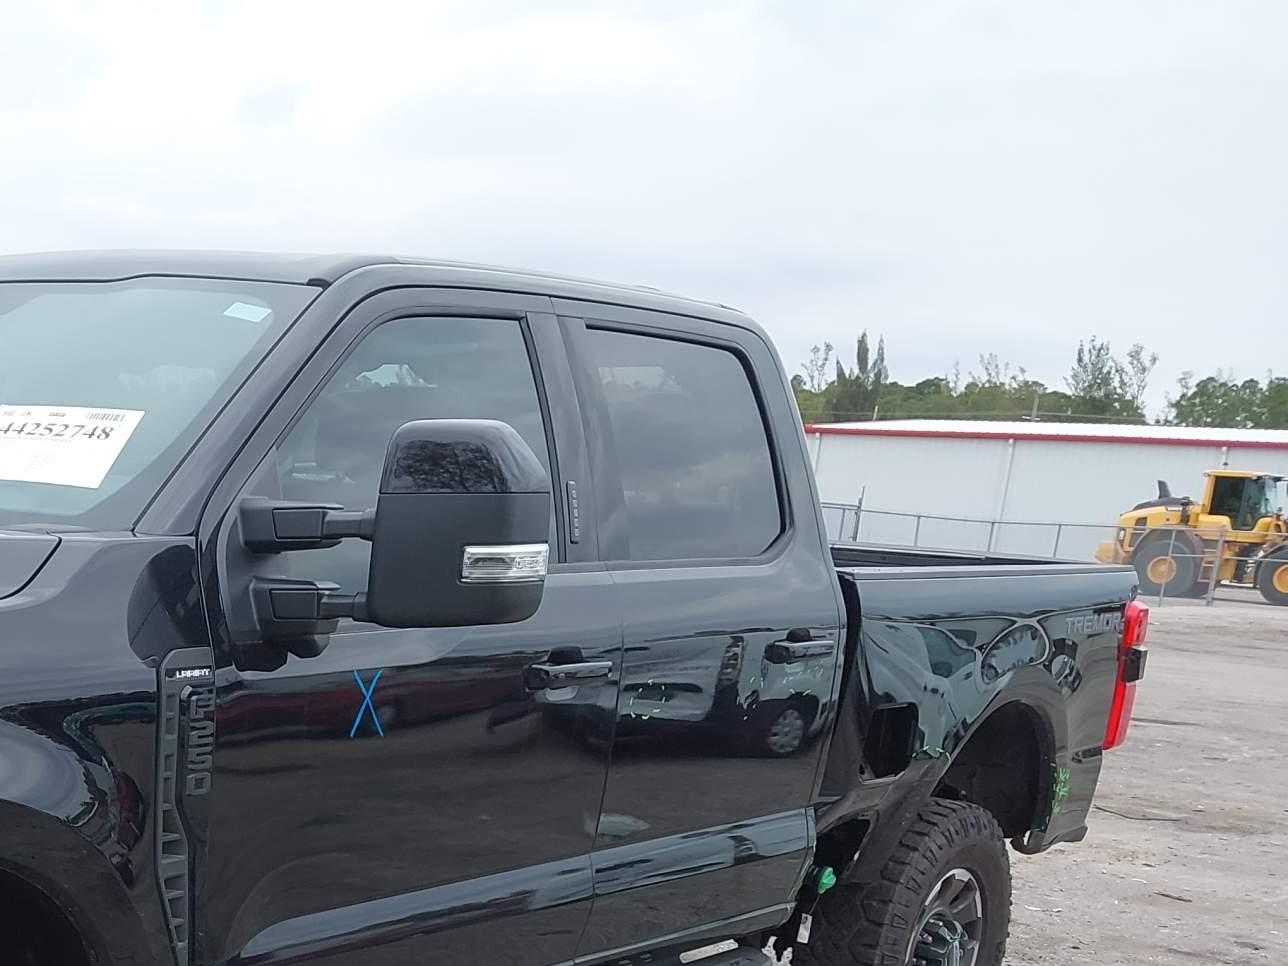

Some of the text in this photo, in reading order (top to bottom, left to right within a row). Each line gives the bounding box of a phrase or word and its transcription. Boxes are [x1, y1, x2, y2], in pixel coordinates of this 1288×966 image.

[0, 421, 114, 441] 44252748
[1065, 611, 1122, 635] TREMOR
[176, 668, 211, 679] LARIAT
